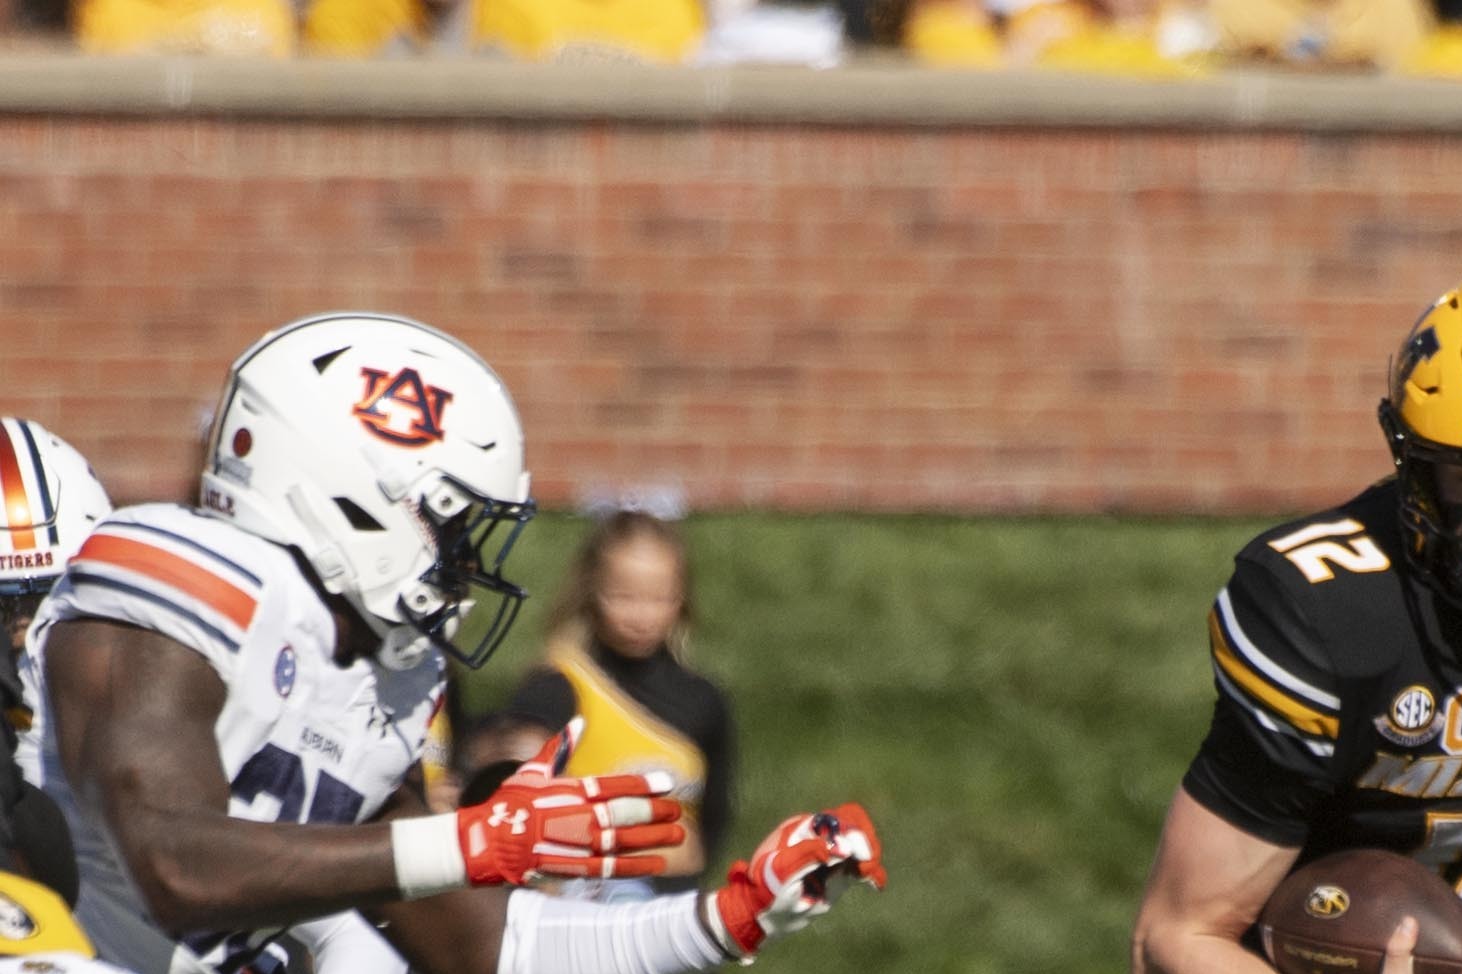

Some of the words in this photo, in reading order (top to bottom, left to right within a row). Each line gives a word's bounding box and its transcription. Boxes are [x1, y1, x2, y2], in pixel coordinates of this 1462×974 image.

[0, 551, 54, 570] TIGERS
[1265, 517, 1391, 584] 12
[1393, 690, 1432, 729] SEC
